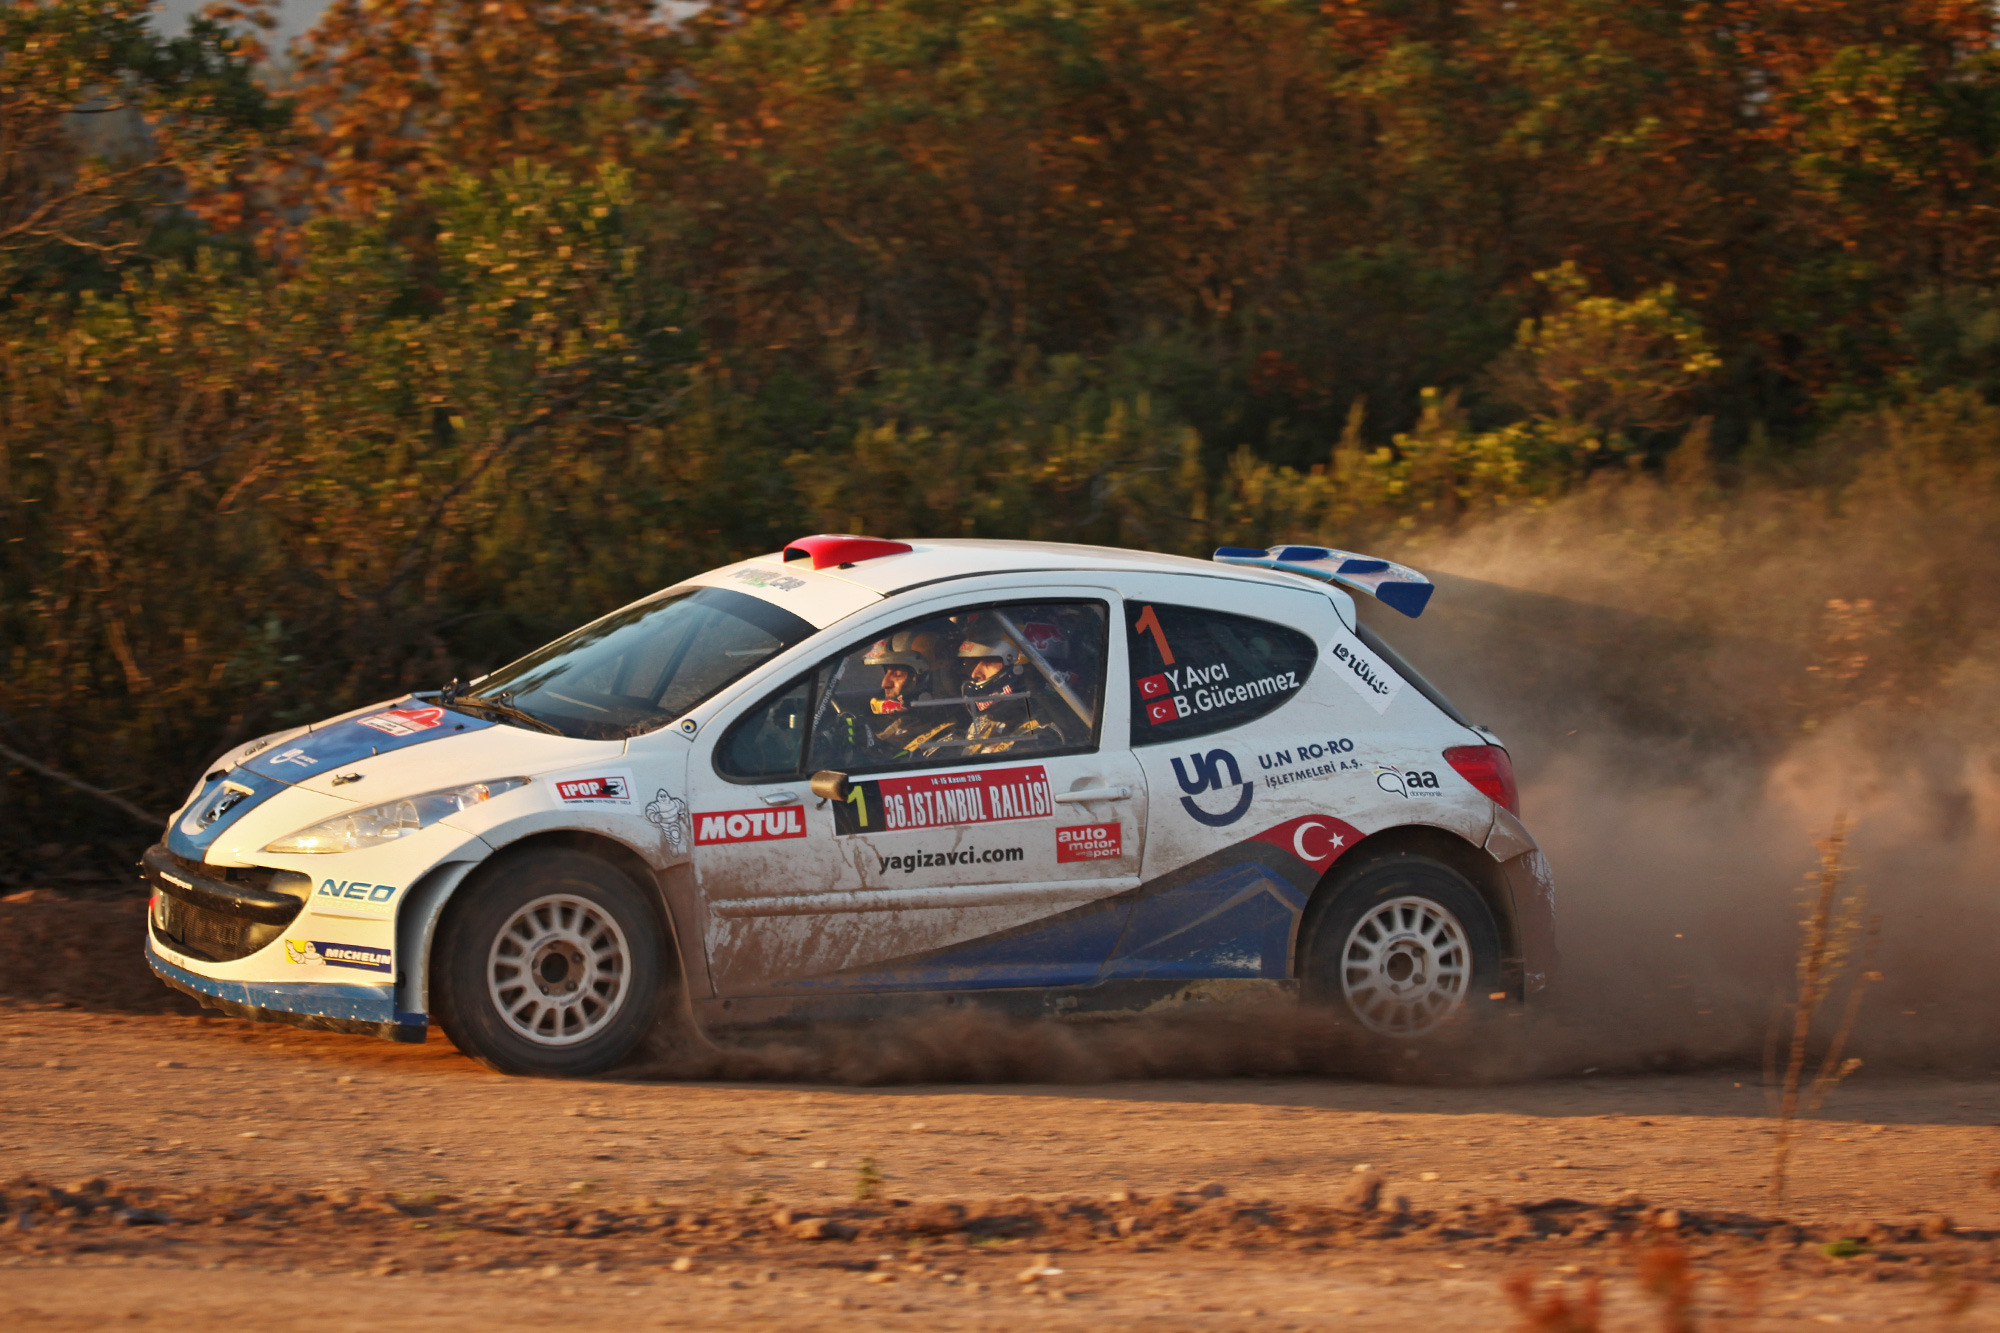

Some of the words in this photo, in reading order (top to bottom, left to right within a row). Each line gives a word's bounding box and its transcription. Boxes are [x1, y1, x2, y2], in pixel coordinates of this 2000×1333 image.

[1135, 604, 1175, 666] 1
[1164, 662, 1230, 692] Y.Avcı
[1173, 671, 1300, 718] B.Gücenmez
[1258, 750, 1293, 769] U.N
[1297, 738, 1354, 761] RO-RO
[1264, 761, 1336, 789] İŞLETMELERİ
[1340, 758, 1363, 772] A.Ş.
[561, 781, 600, 797] iPOP
[989, 773, 1051, 819] RALLİSİ
[847, 785, 869, 827] 1
[699, 810, 802, 841] MOTUL
[1058, 827, 1107, 843] auto
[1069, 839, 1116, 851] motor
[879, 846, 1024, 876] yagizavci.com
[317, 878, 397, 903] NEO
[324, 948, 392, 965] MICHELIN
